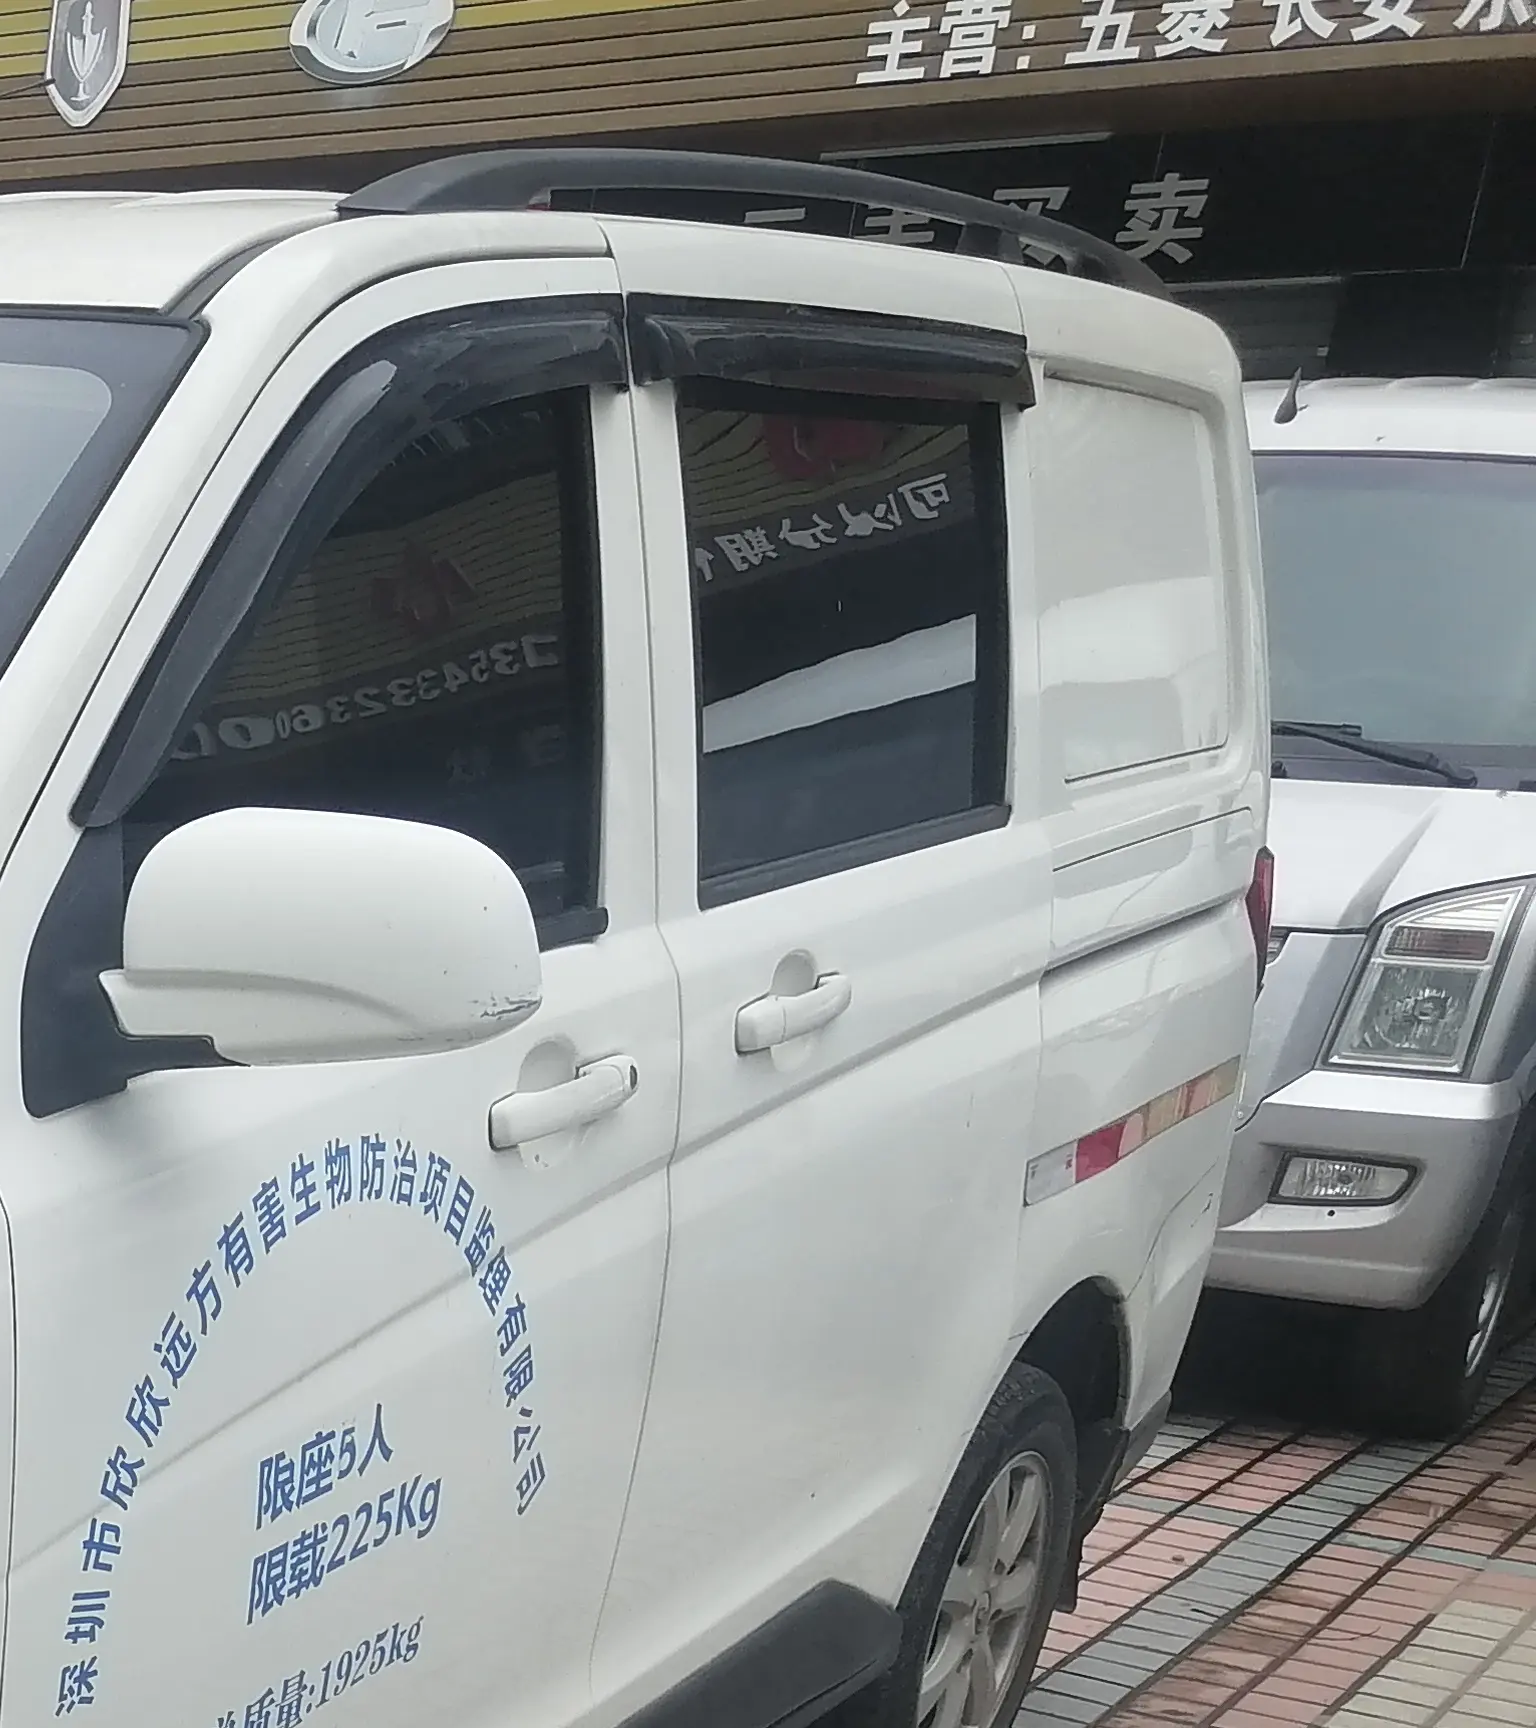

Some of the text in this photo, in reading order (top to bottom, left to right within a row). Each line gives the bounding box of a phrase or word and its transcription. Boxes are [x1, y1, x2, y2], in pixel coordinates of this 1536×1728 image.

[54, 1132, 548, 1718] 深圳市欣欣远方有害生物防治项目监理有限公司
[255, 1403, 394, 1530] 限座5人
[246, 1476, 443, 1626] 限载225Kg
